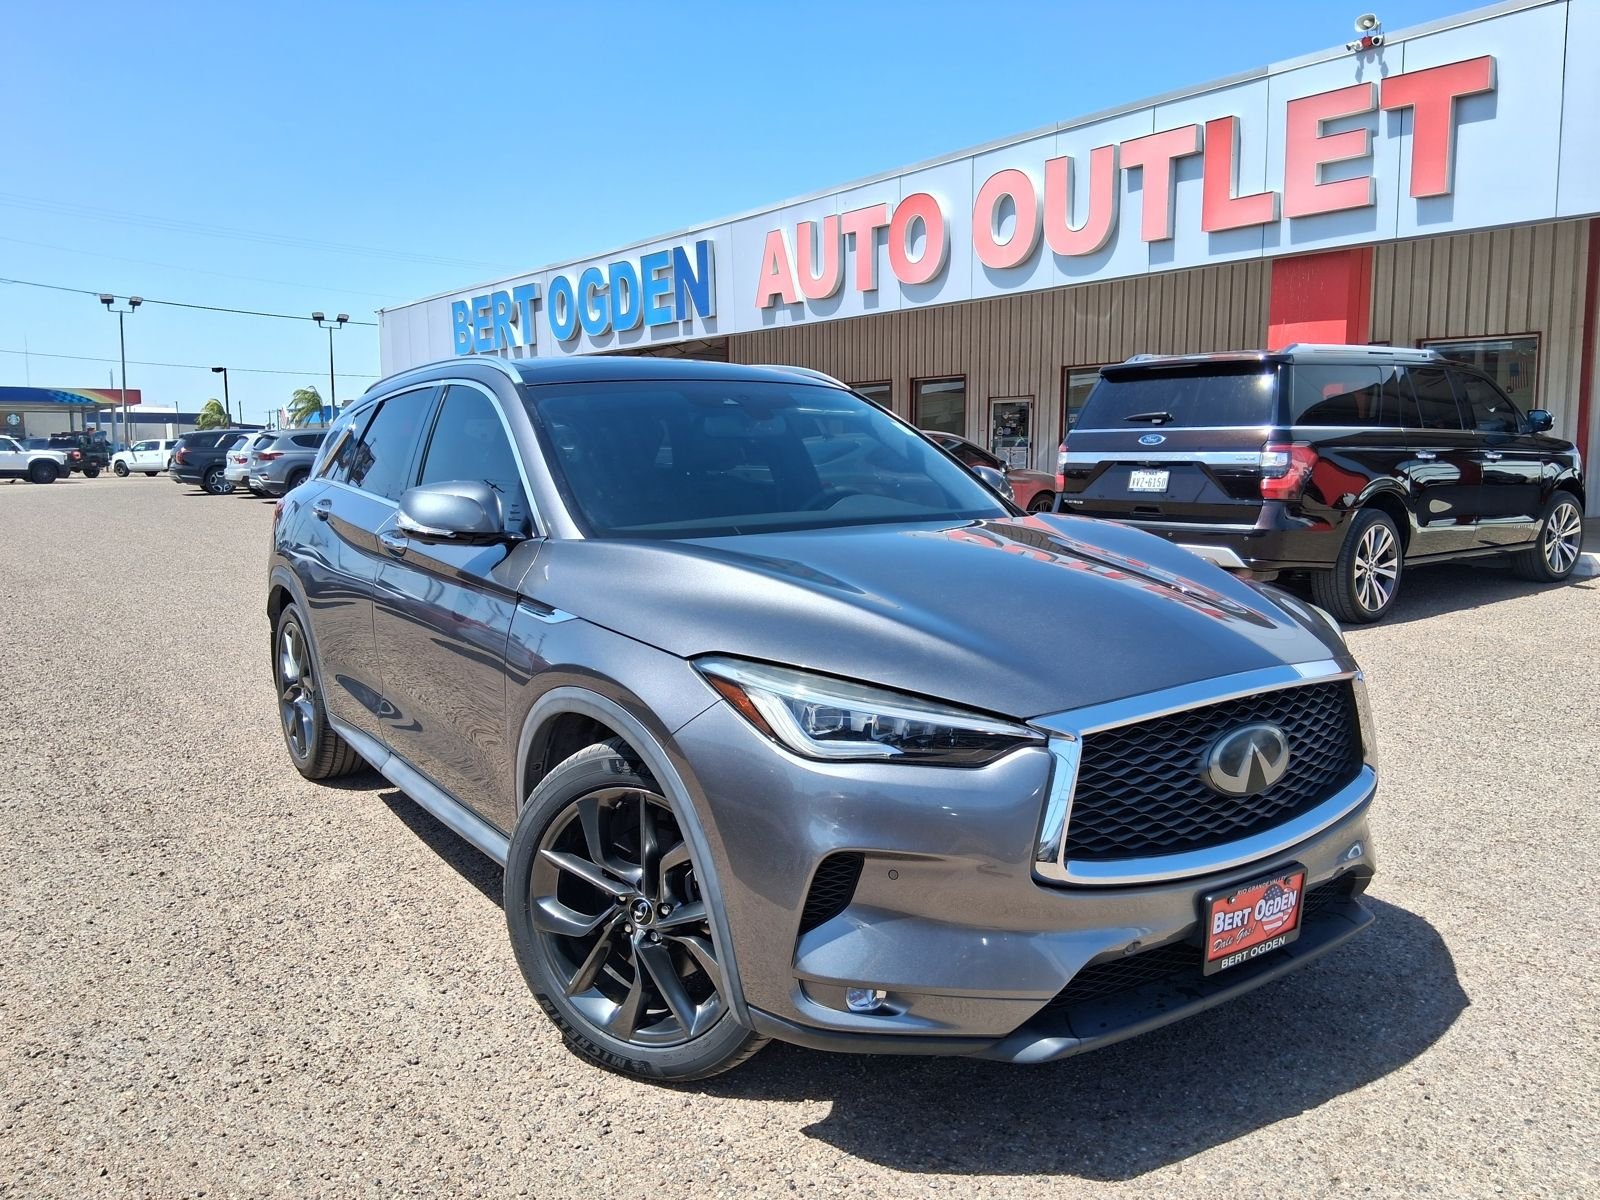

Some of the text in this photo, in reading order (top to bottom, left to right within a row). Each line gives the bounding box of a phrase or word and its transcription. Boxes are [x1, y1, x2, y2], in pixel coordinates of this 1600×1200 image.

[451, 54, 1498, 356] BERT OGDEN AUTO OUTLET
[1213, 890, 1298, 935] BERT OGDEN
[1221, 936, 1286, 969] BERT OGDEN
